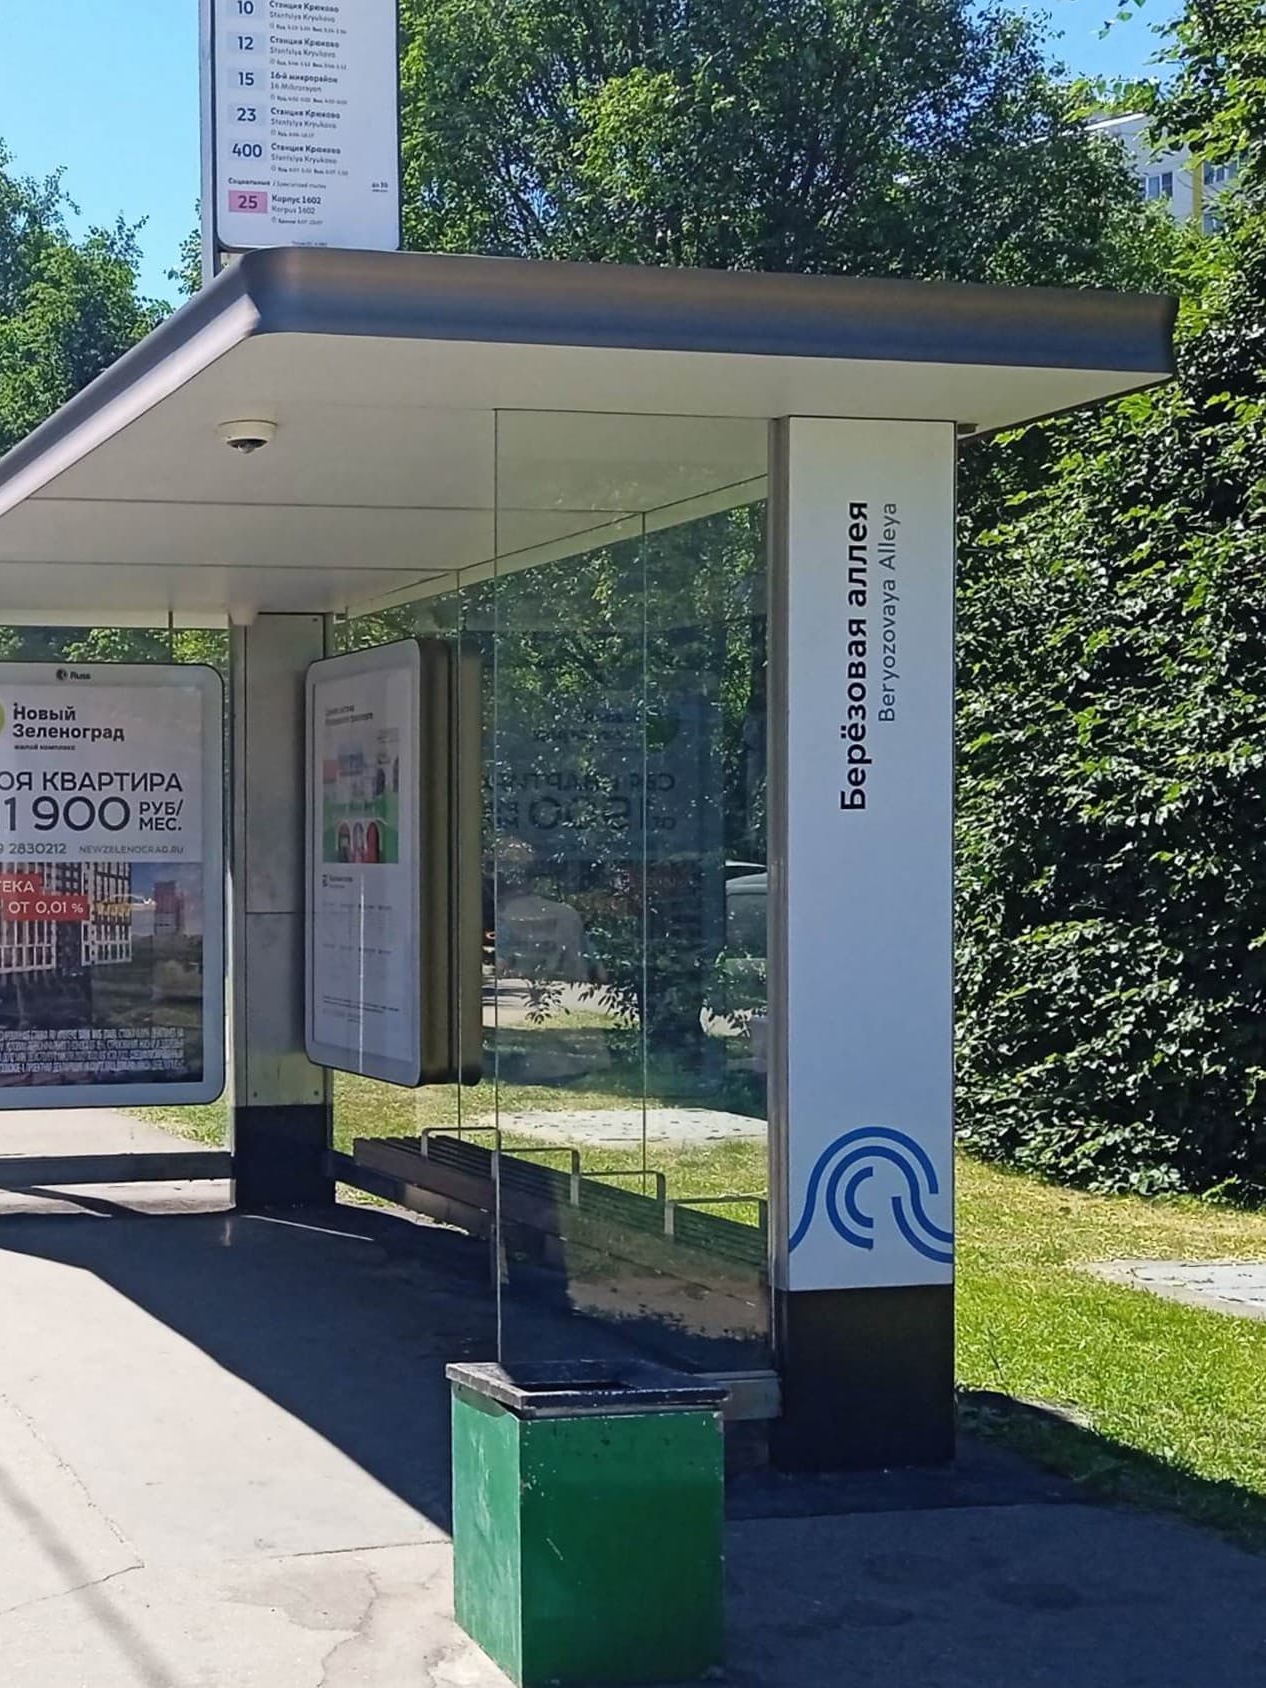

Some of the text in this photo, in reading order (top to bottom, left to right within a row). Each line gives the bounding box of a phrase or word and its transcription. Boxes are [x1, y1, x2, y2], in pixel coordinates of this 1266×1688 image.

[238, 0, 254, 15] 10
[269, 0, 340, 13] Станция Крюково
[237, 36, 254, 50] 12
[270, 36, 340, 48] Станция Крюково
[238, 72, 255, 86] 15
[237, 107, 256, 122] 23
[270, 107, 341, 119] Станция Крюково
[232, 143, 263, 158] 400
[271, 142, 304, 152] Станция
[238, 195, 258, 209] 25
[271, 194, 322, 205] Корпус 1602
[298, 206, 315, 215] 1602
[877, 503, 901, 722] Beryozovaya Alleya
[840, 502, 872, 810] Берёзовая аллея
[13, 704, 76, 721] Новый
[12, 724, 125, 742] Зеленоград
[42, 772, 183, 792] КВАРТИРА
[32, 796, 132, 831] 900
[139, 817, 182, 831] МЕС.
[9, 843, 67, 855] 2830212
[8, 901, 84, 915] ОТ 0,01 %
